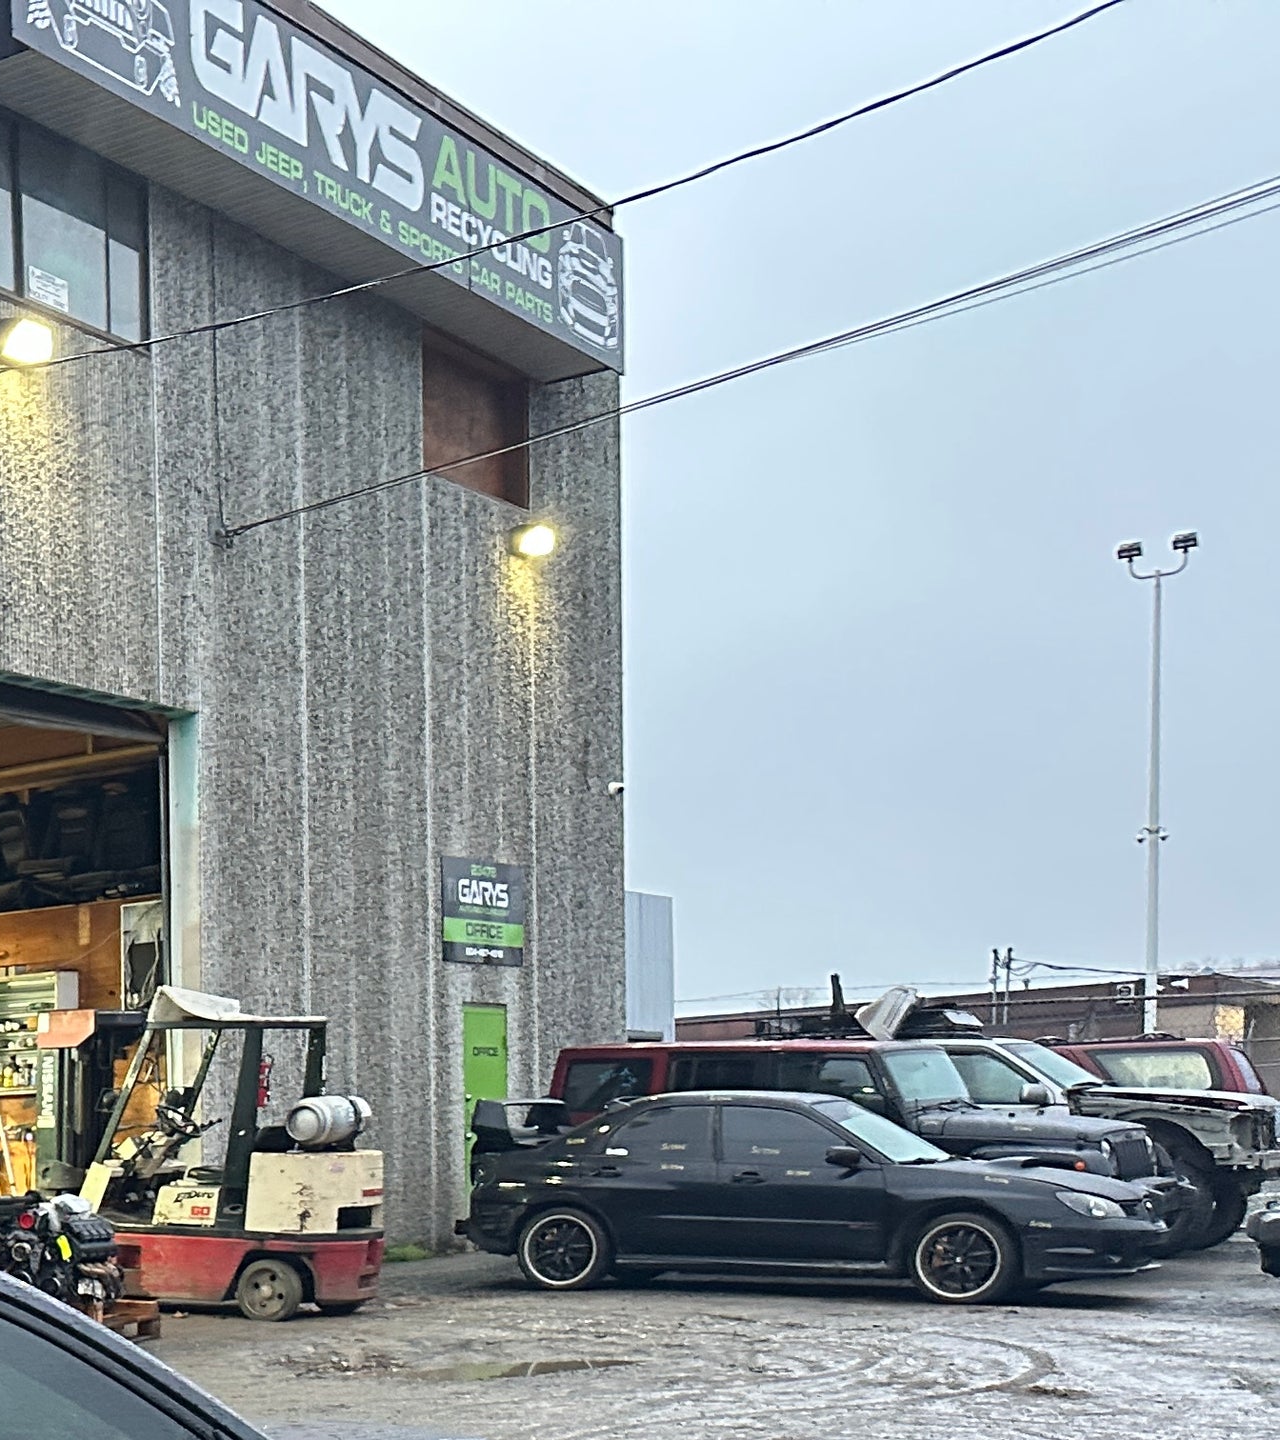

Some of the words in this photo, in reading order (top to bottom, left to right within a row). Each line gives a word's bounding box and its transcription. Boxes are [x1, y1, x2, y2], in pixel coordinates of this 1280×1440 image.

[189, 0, 425, 213] GARYS
[193, 101, 249, 154] USED
[255, 141, 308, 194] JEEP,
[313, 170, 374, 225] TRUCK
[379, 210, 393, 235] &
[397, 220, 464, 275] SPORTS
[470, 261, 501, 296] CAR
[505, 281, 554, 324] PARTS
[430, 191, 553, 290] RECYCLING
[432, 135, 550, 254] AUTO
[458, 878, 509, 908] GARYS
[465, 922, 503, 940] OFFICE
[41, 1055, 55, 1117] NISSAN
